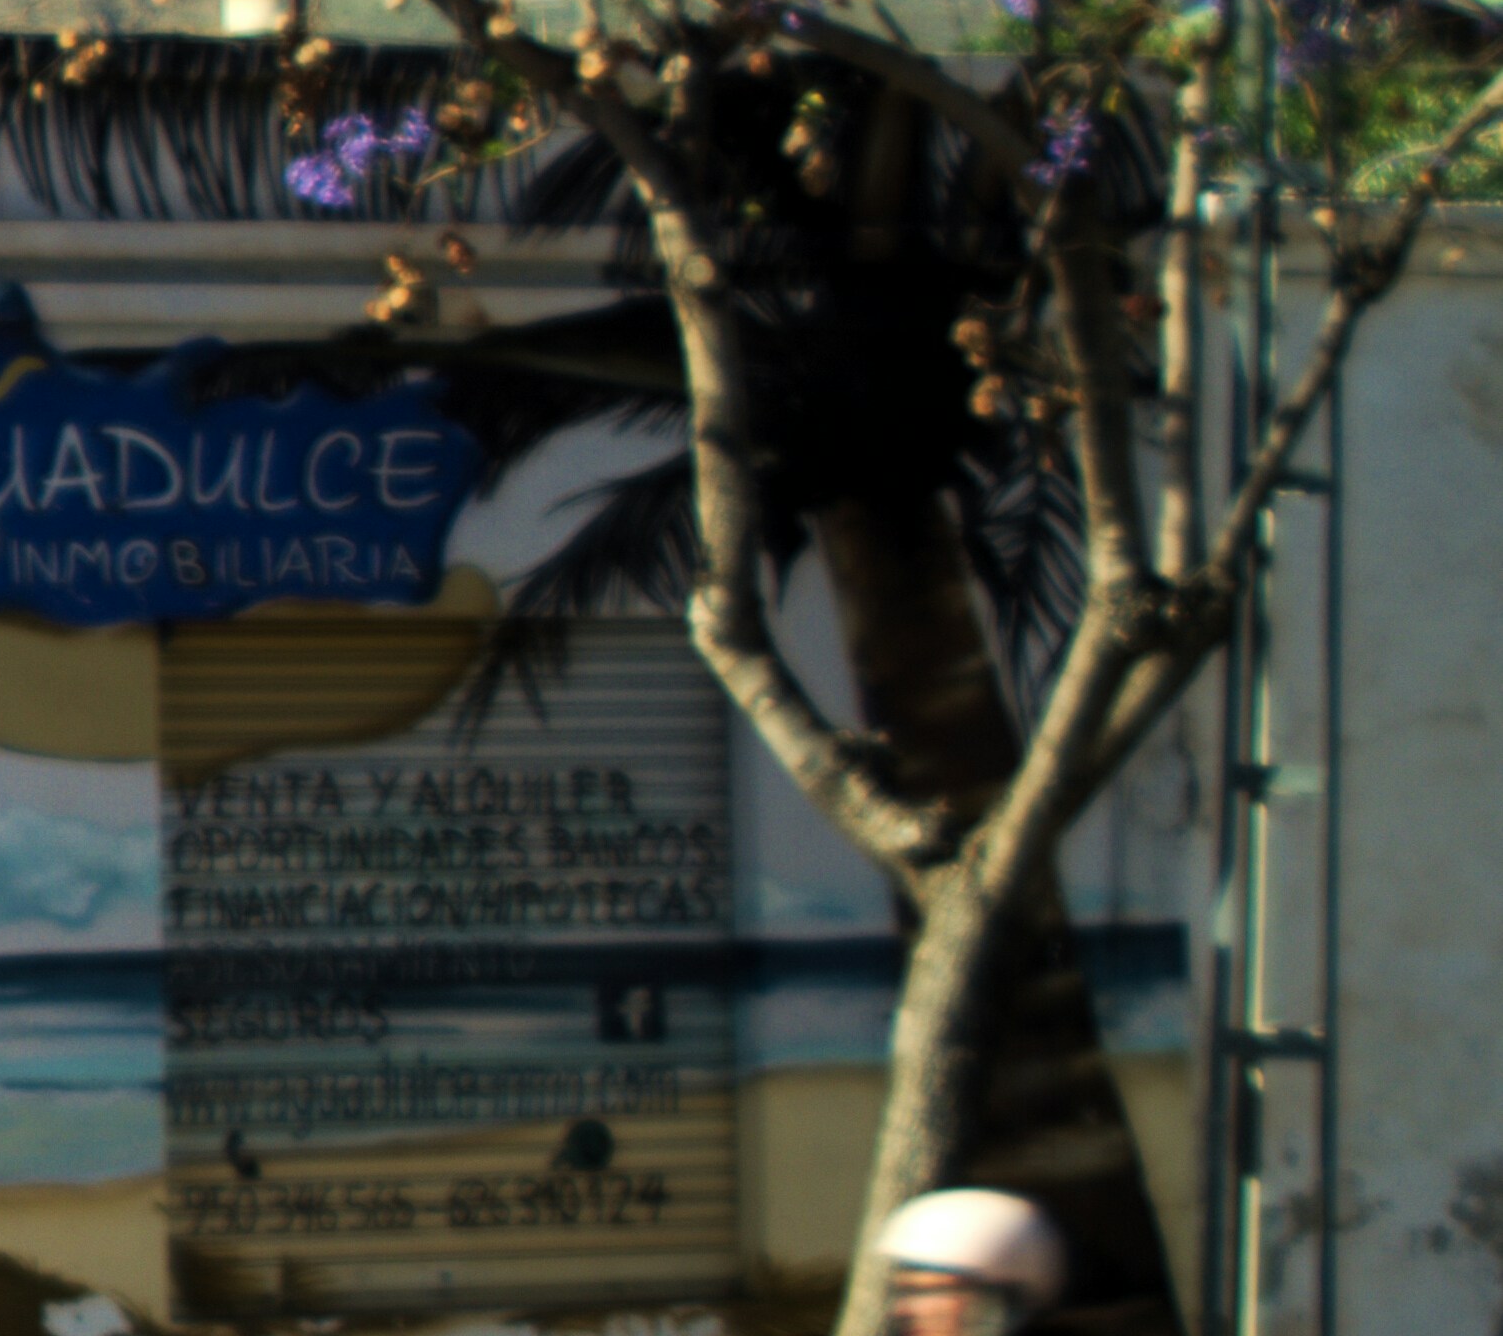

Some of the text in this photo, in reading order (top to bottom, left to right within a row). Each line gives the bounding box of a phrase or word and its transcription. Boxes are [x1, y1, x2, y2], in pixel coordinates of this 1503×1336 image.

[6, 538, 429, 588] INMOBILIARIA
[173, 772, 345, 818] VENTA
[171, 994, 389, 1046] SEGUROS
